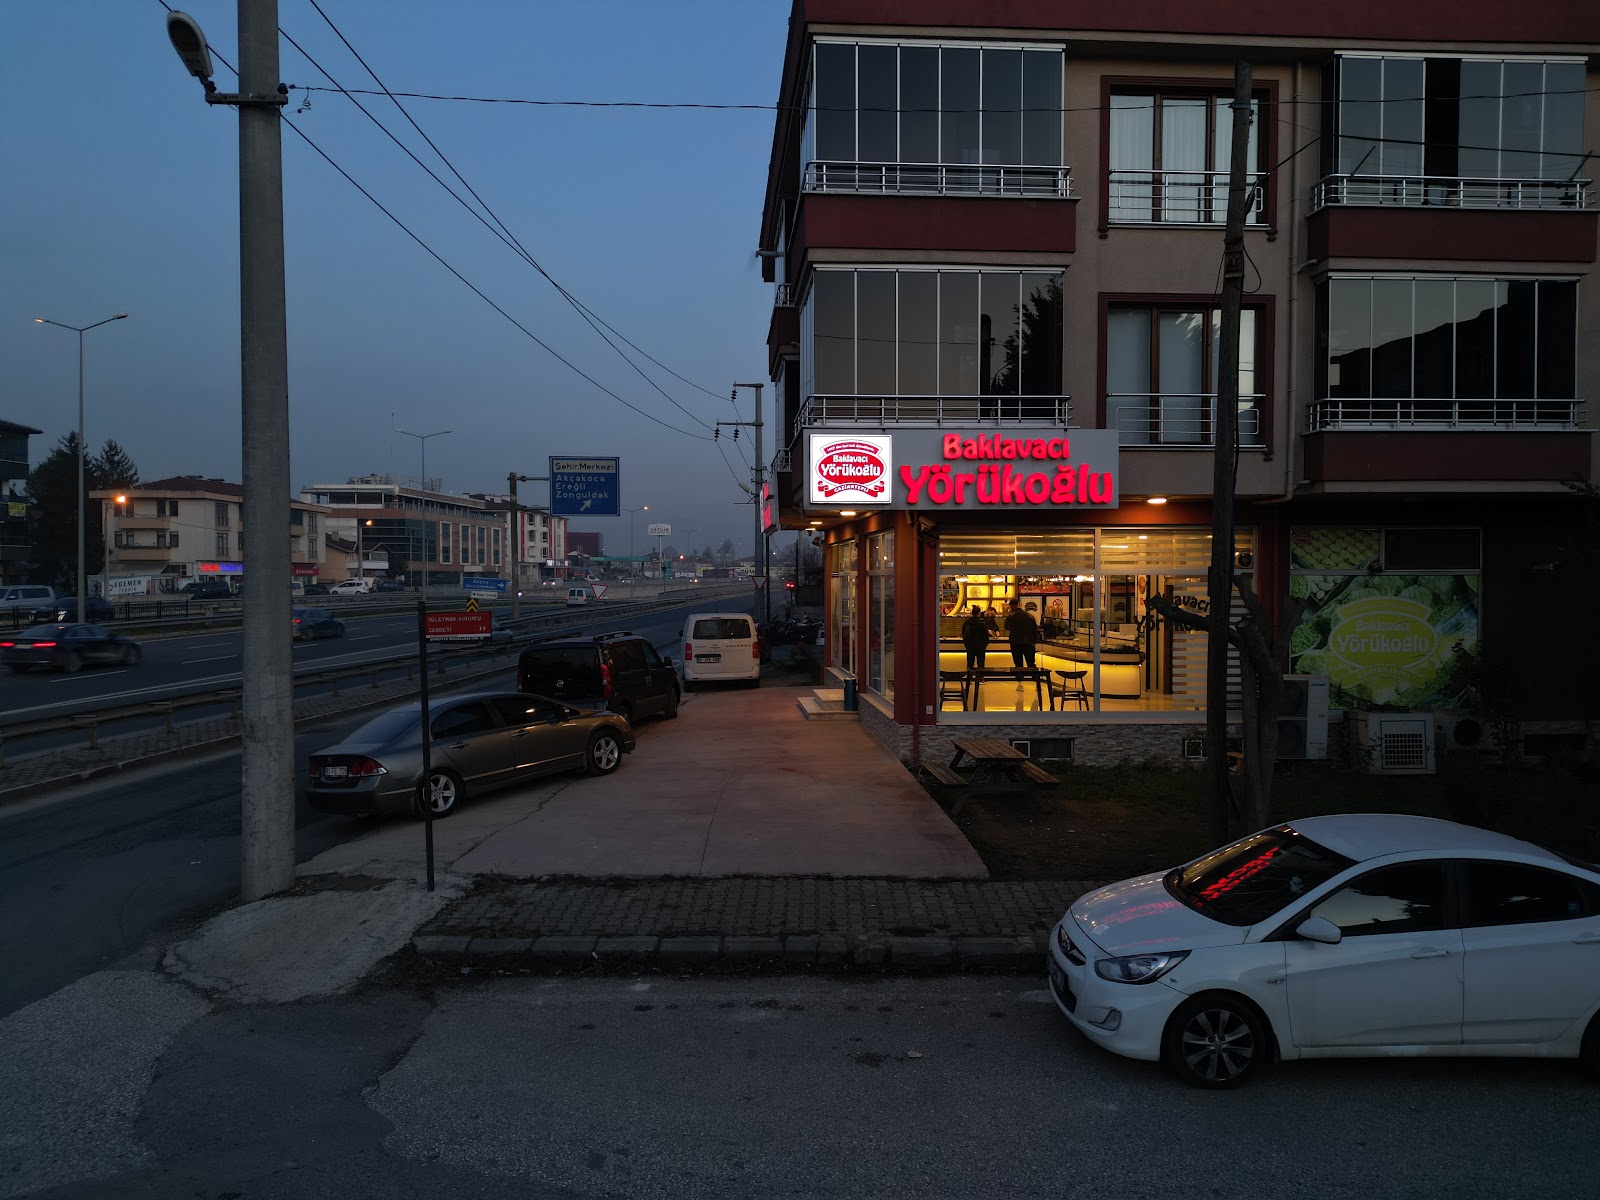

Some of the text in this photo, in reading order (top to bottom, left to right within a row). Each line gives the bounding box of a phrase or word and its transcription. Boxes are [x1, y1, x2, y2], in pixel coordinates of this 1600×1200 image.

[943, 433, 1070, 459] Baklavacı
[832, 454, 868, 463] Baklavacı
[555, 462, 578, 470] Şehir
[820, 463, 880, 476] Yörükoğlu
[556, 474, 605, 482] Akçakoca
[555, 482, 586, 491] Ereğli
[899, 463, 1113, 504] Yörükoğlu
[555, 491, 609, 500] Zonguldak
[114, 579, 142, 588] EGEMEN
[1337, 633, 1430, 654] Yörükoğlu
